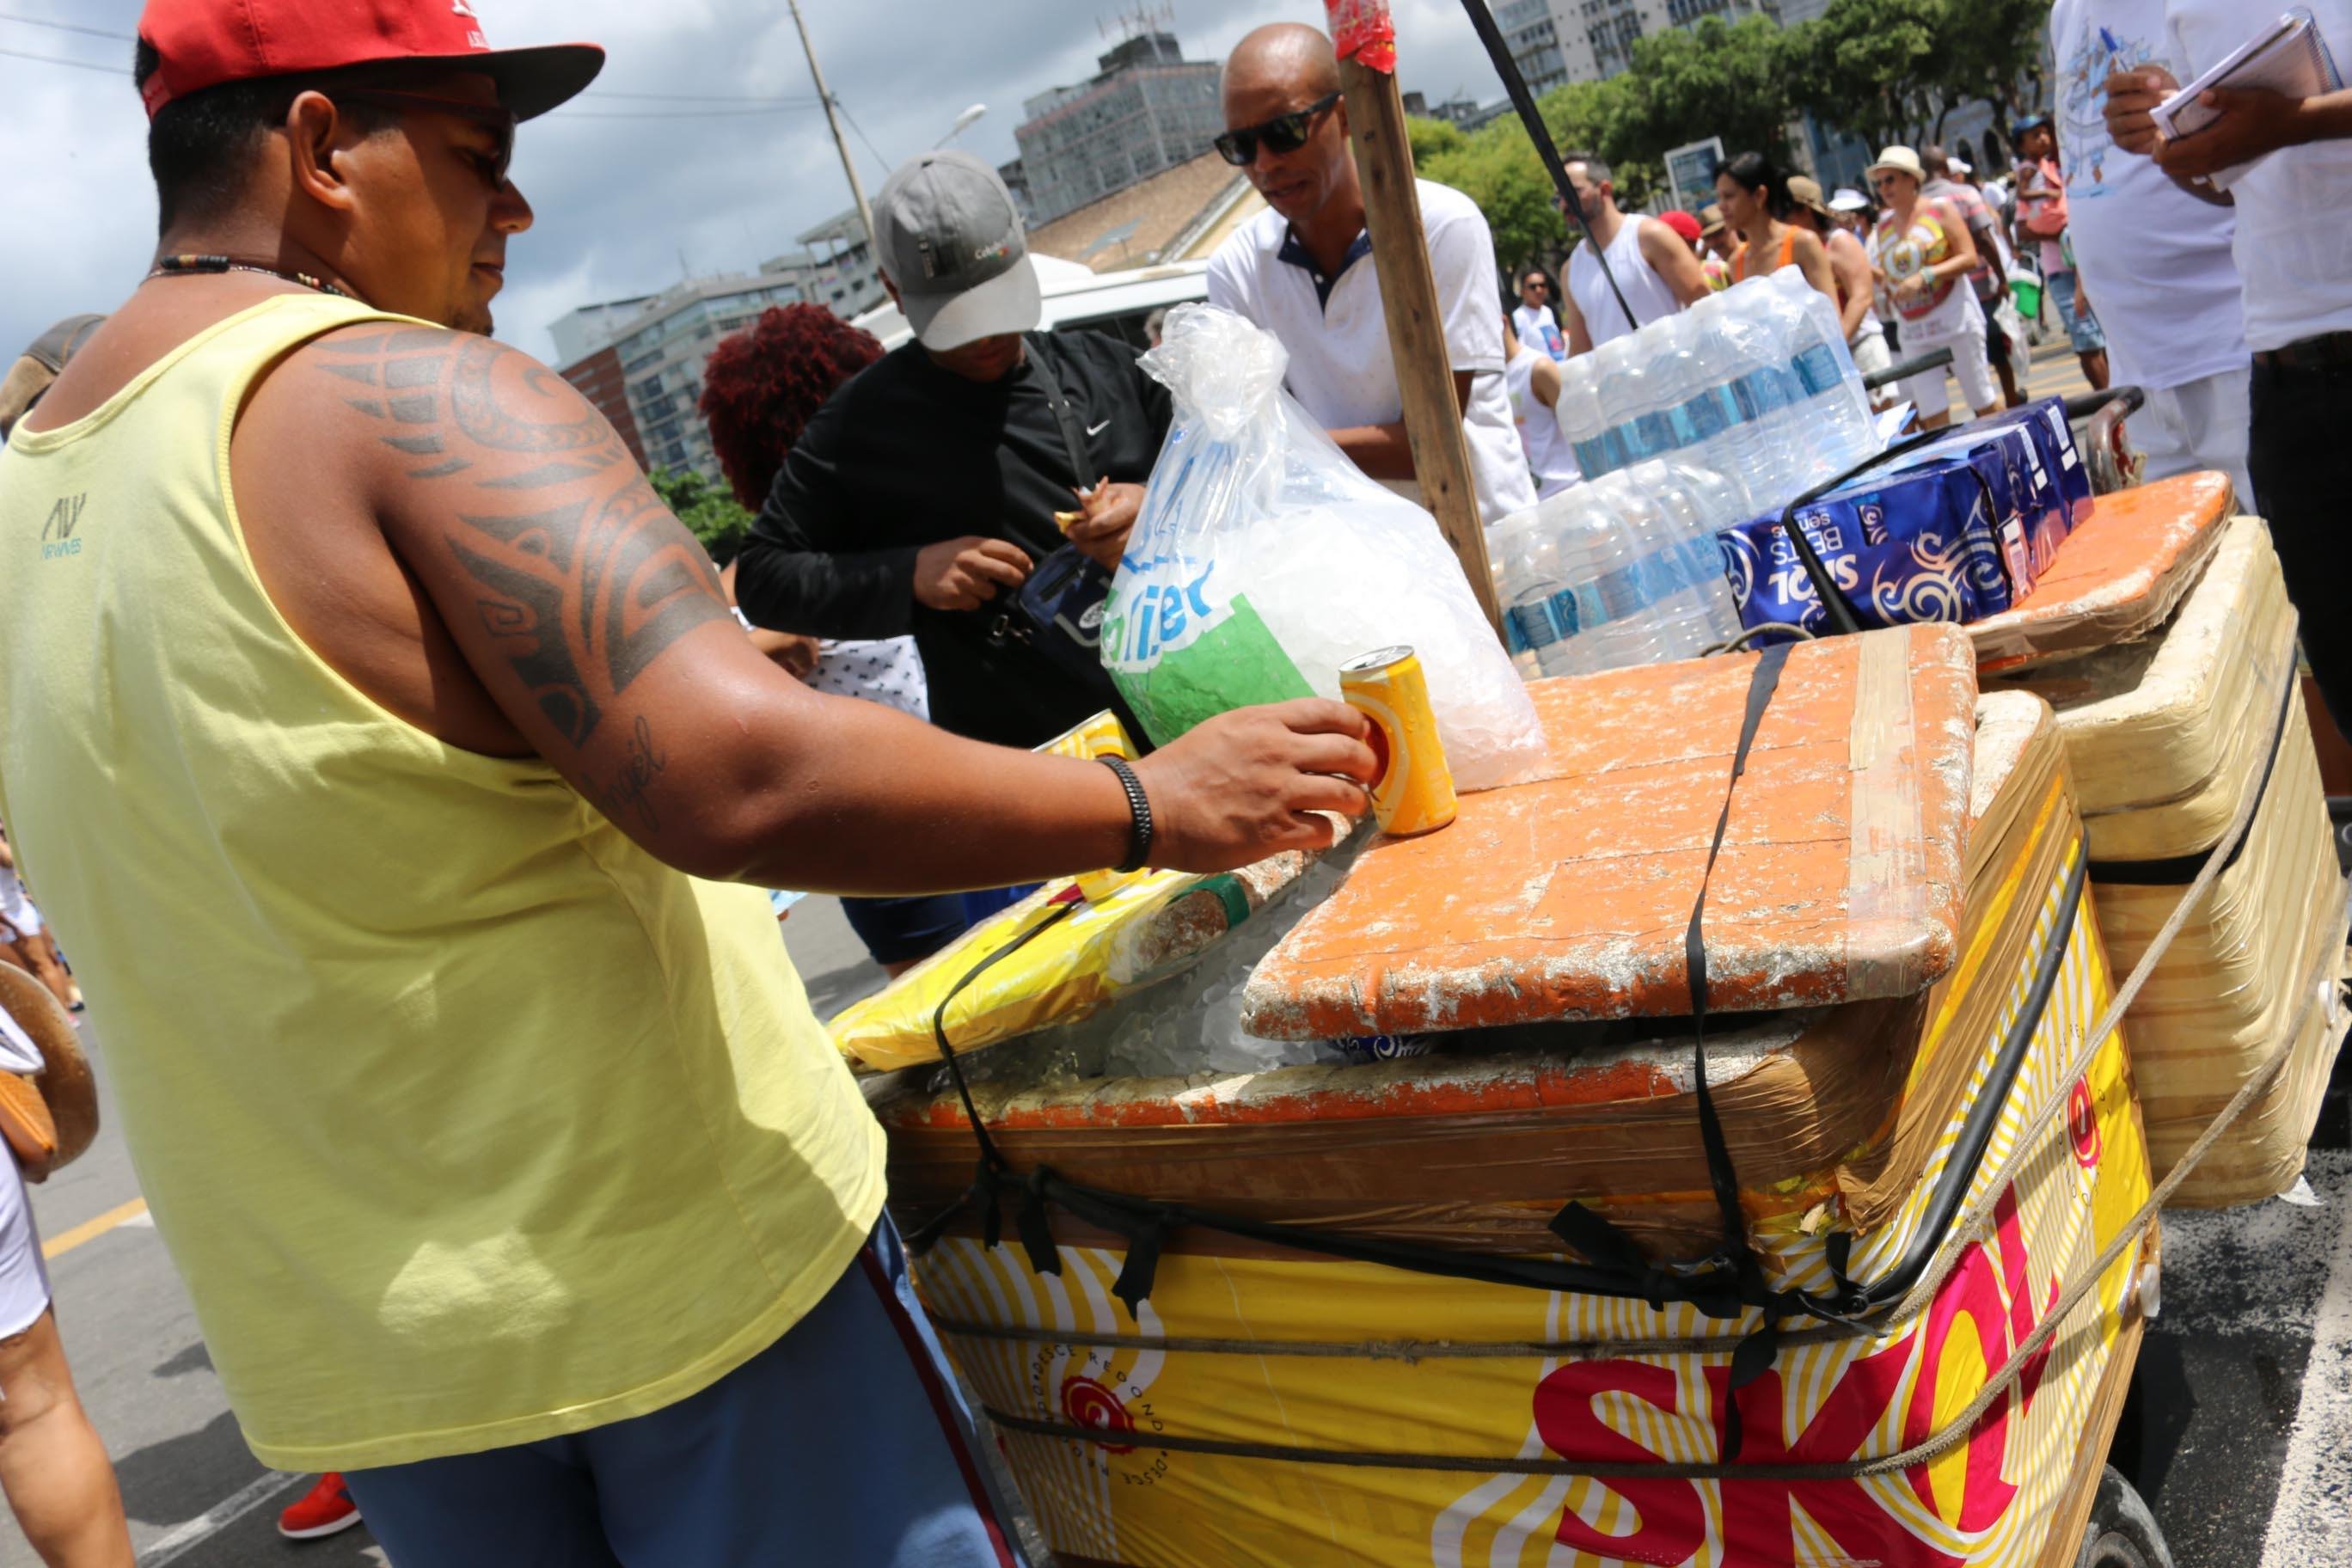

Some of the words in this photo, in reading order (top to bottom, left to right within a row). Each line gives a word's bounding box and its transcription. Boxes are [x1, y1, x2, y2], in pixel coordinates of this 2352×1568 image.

[1770, 526, 1844, 566] BETS
[1088, 1351, 1164, 1432] REDOND
[1533, 1178, 2061, 1568] SKOL
